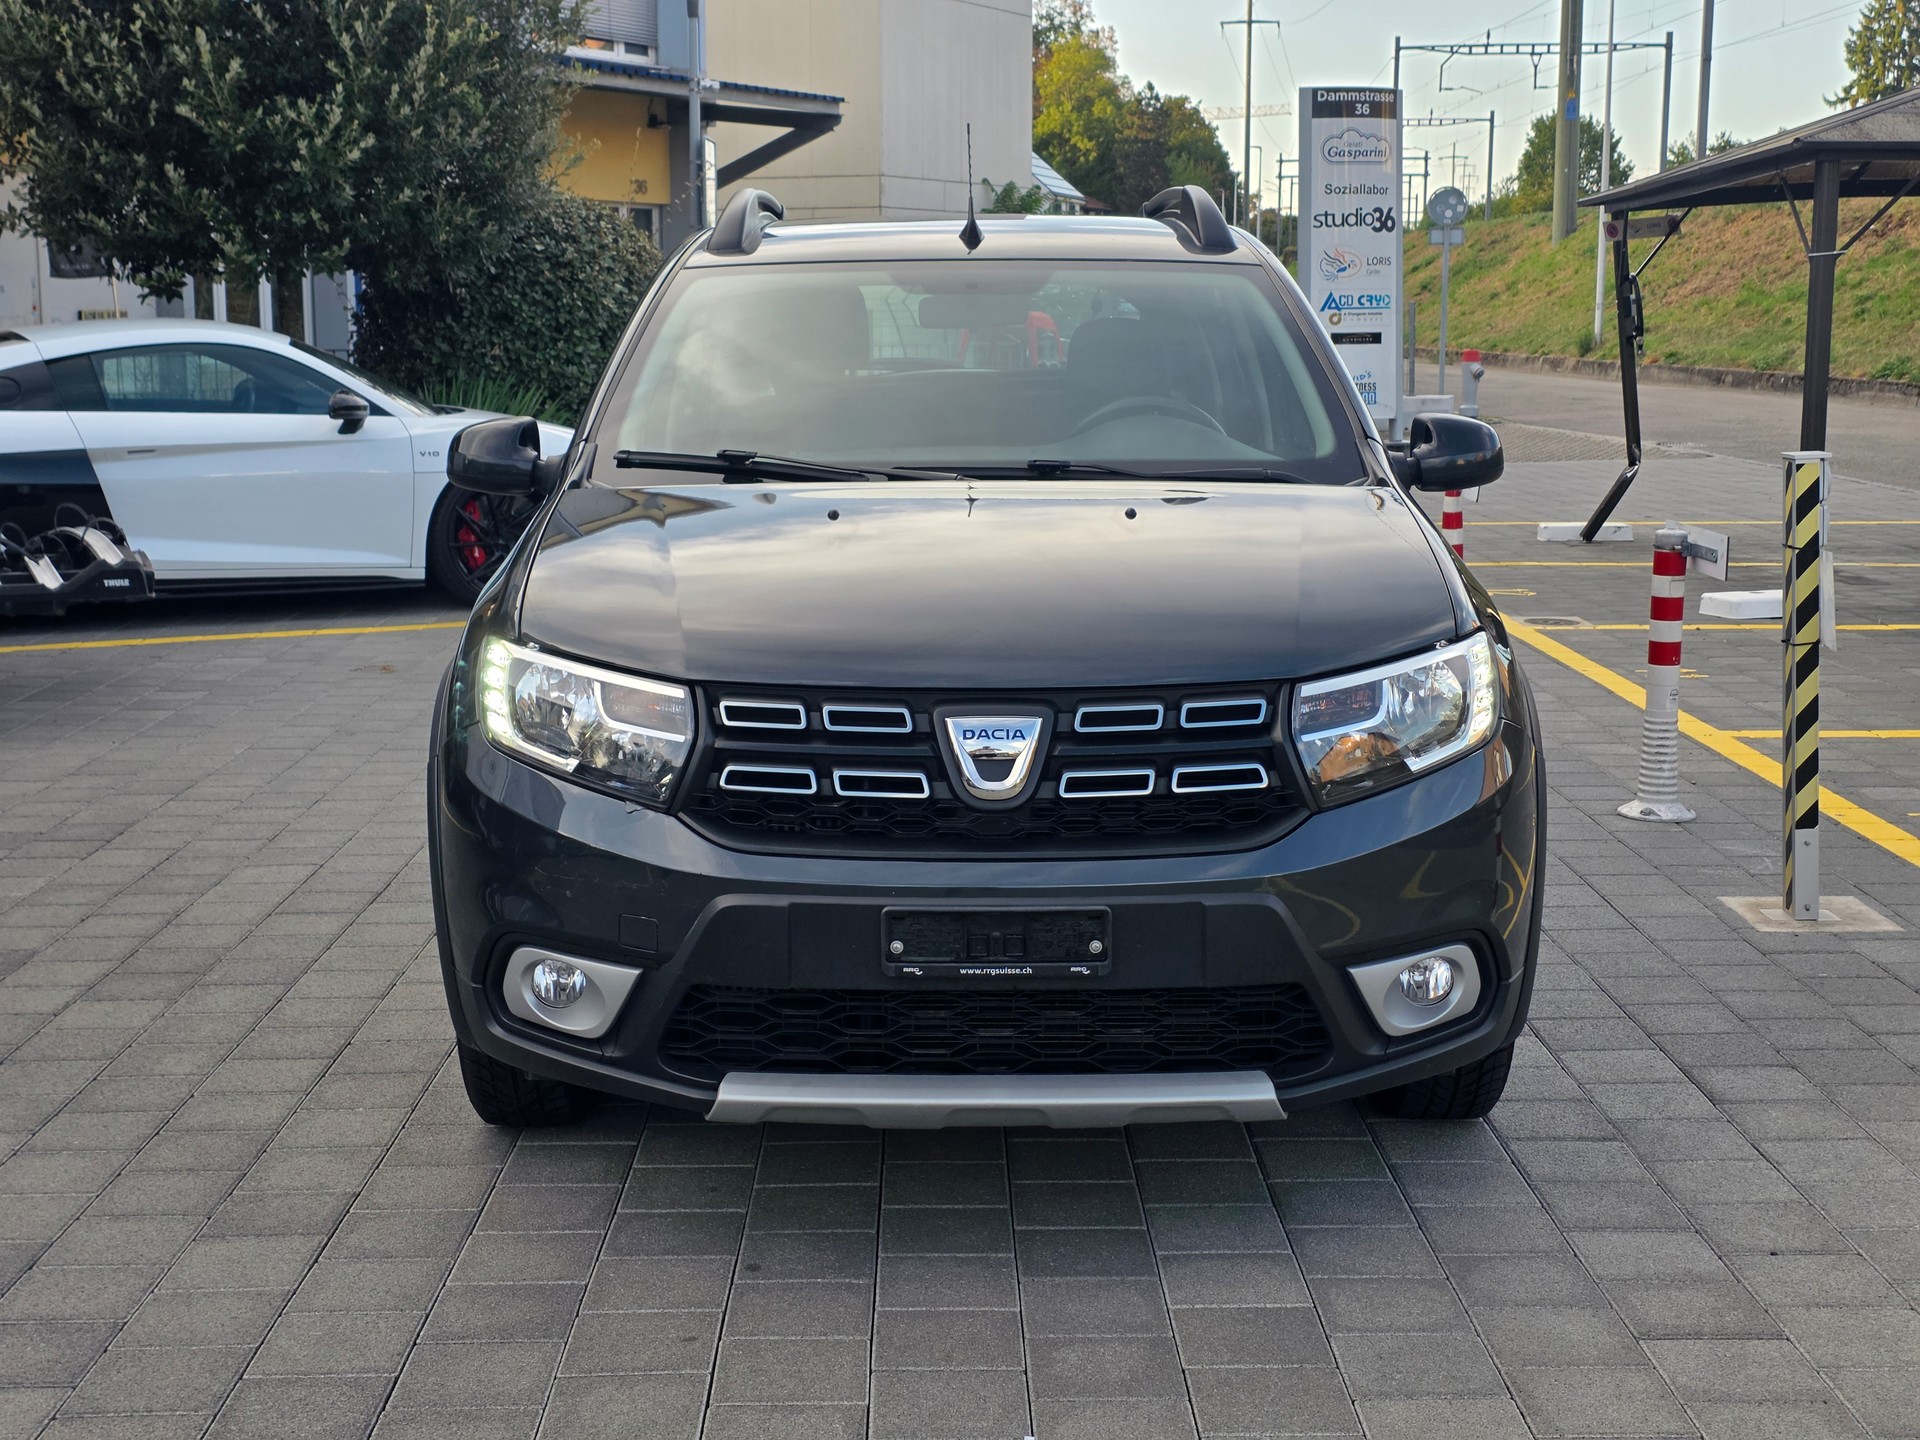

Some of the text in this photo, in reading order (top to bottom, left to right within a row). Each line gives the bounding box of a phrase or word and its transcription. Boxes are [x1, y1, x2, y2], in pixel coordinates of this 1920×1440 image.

[1317, 90, 1394, 102] Dammstrasse
[1355, 103, 1370, 115] 36
[1327, 146, 1387, 160] Gasparini
[633, 179, 648, 195] 36
[1324, 184, 1389, 195] Soziallabor
[1313, 207, 1396, 233] studio36
[1366, 256, 1392, 266] LORIS
[103, 579, 130, 587] THULE
[962, 728, 1026, 740] DACIA
[959, 966, 1033, 975] www.rrgsuisse.ch
